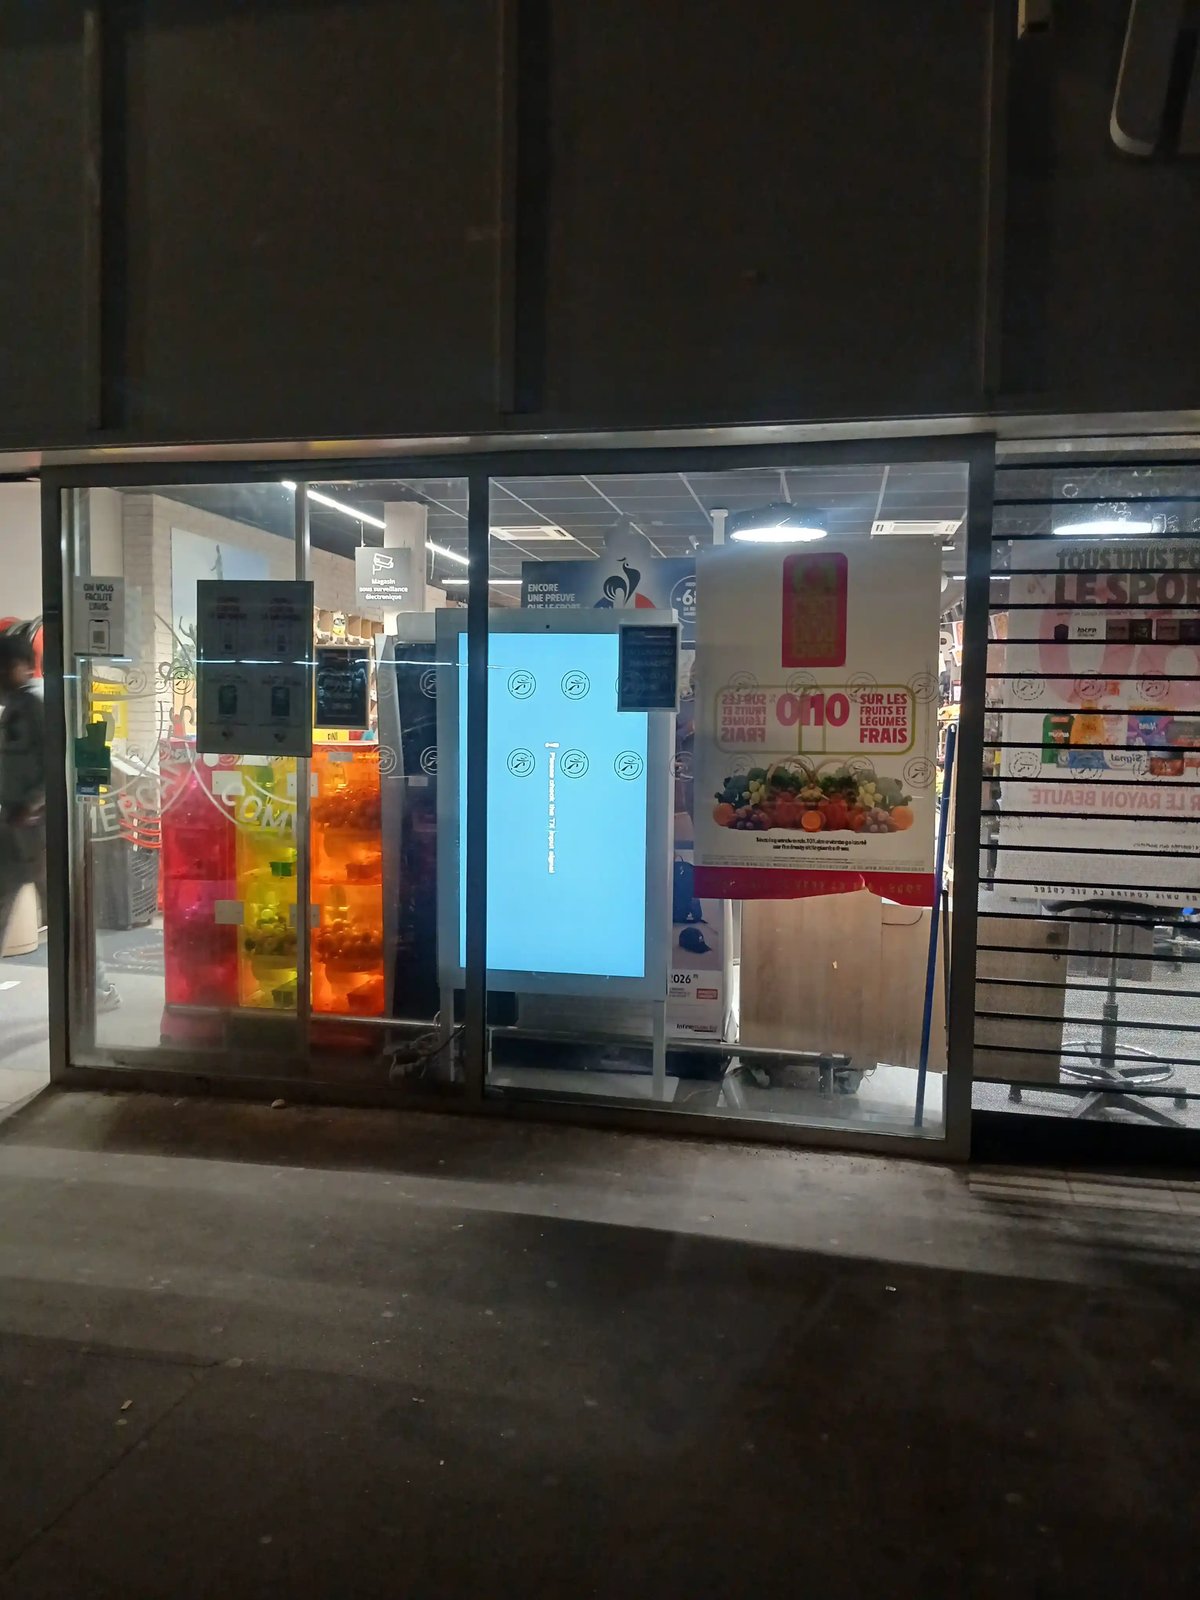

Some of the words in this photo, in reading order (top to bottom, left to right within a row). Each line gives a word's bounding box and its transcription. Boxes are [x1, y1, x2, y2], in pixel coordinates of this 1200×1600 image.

[528, 583, 559, 592] ENCORE
[1055, 573, 1097, 604] LE
[527, 593, 544, 602] UNE
[545, 593, 576, 602] PREUVE
[676, 589, 697, 606] -6
[860, 693, 884, 705] SUR
[887, 693, 908, 705] LES
[860, 706, 893, 716] FRUITS
[896, 706, 907, 716] ET
[860, 728, 908, 744] FRAIS
[548, 751, 556, 779] Please
[548, 779, 556, 802] check
[548, 803, 556, 817] the
